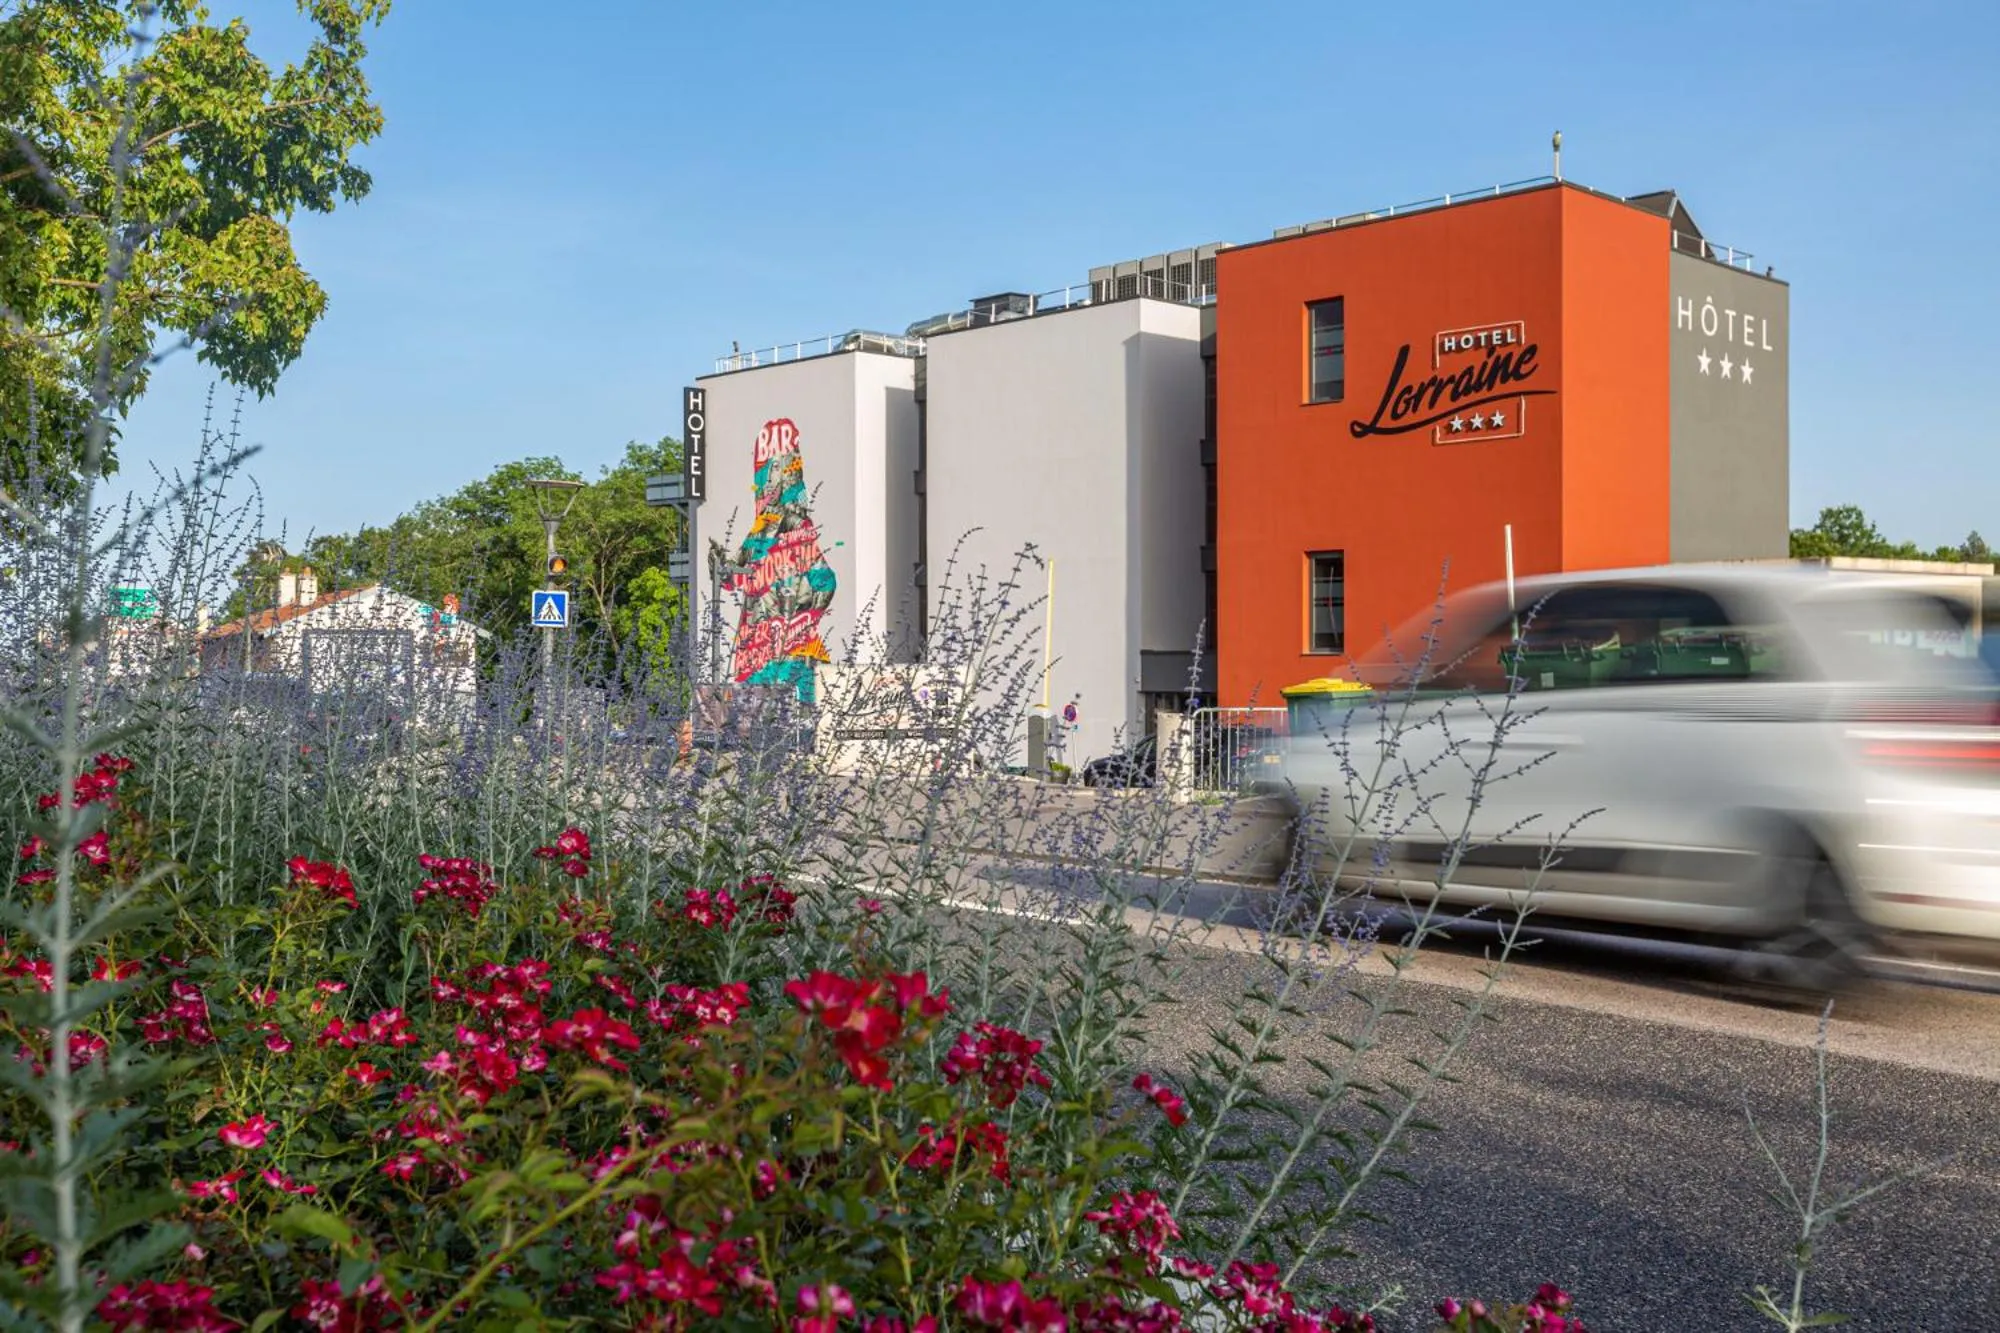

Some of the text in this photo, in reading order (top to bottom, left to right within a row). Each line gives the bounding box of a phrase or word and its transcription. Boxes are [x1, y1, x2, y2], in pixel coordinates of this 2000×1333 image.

[1444, 328, 1517, 353] HOTEL
[1677, 295, 1773, 352] HÔTEL
[1351, 343, 1547, 438] Lorraine
[687, 390, 705, 497] HOTEL
[756, 423, 795, 463] BAR
